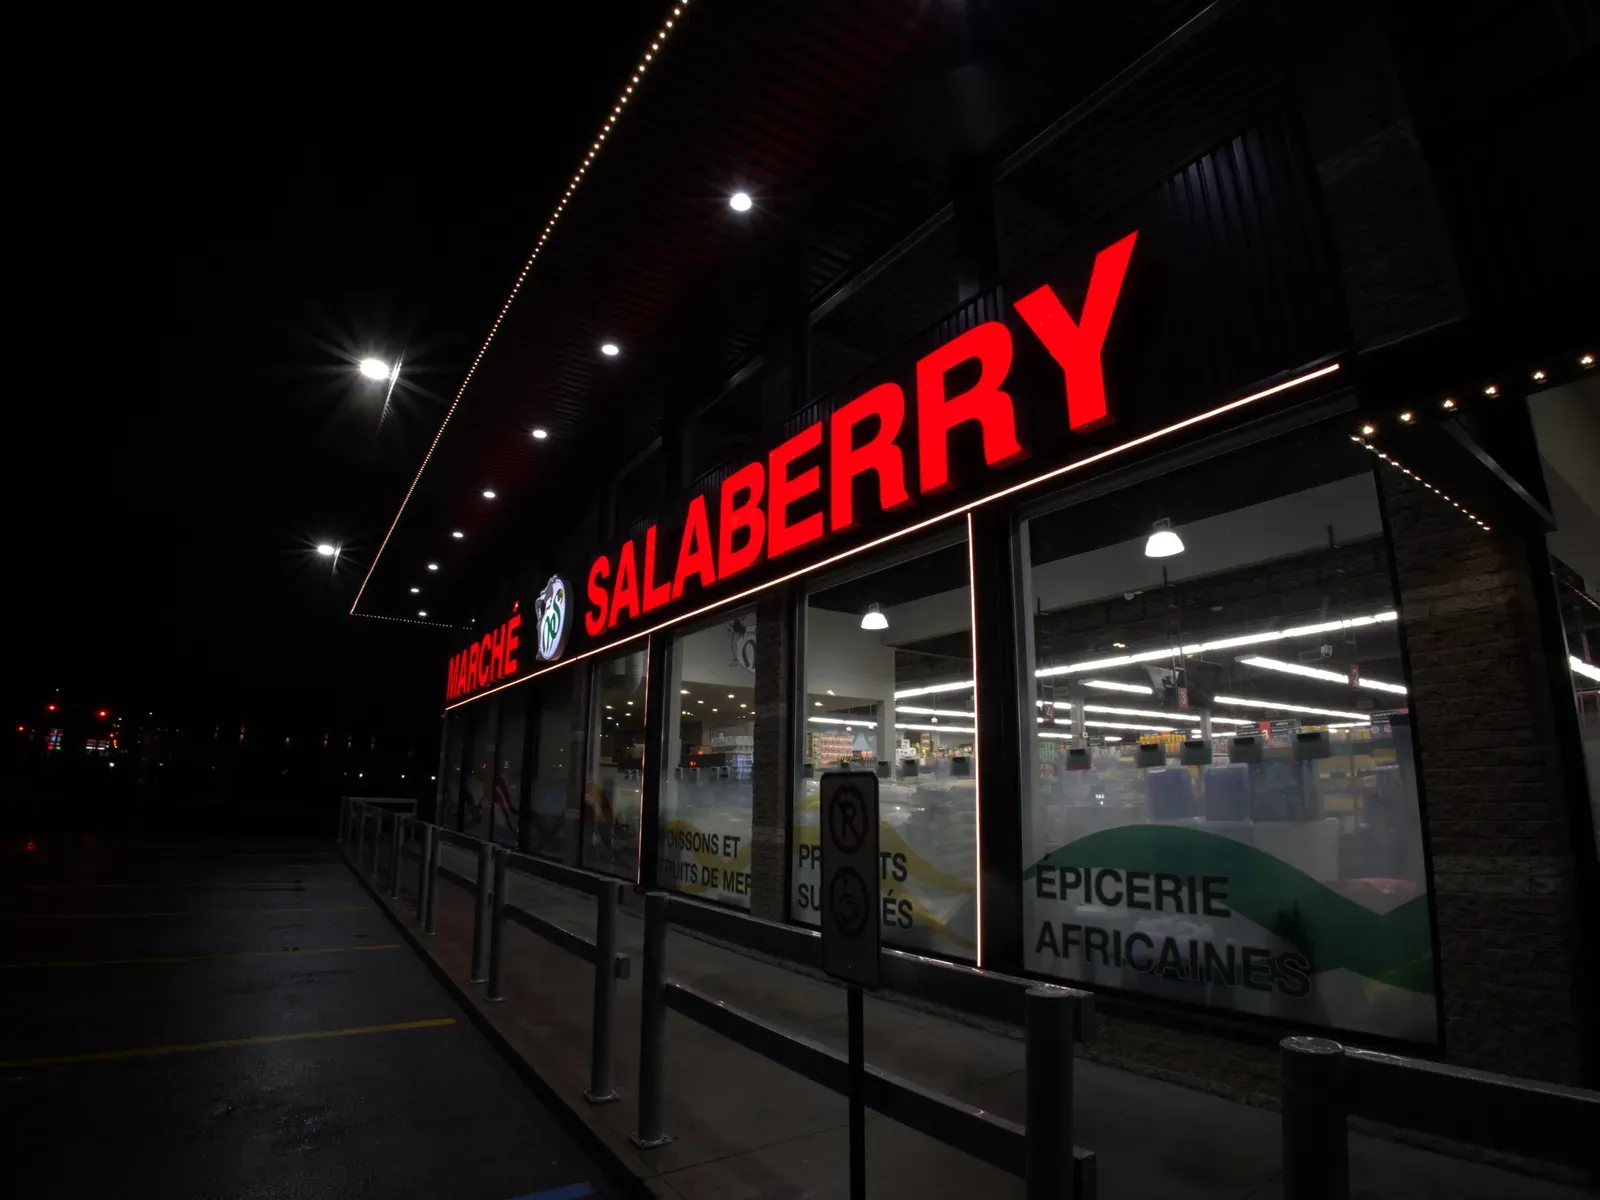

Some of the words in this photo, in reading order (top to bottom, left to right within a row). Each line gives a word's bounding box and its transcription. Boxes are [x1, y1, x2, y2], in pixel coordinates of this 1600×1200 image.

[446, 600, 523, 700] MARCHÉ
[585, 230, 1138, 637] SALABERRY
[665, 831, 719, 855] OISSONS
[723, 835, 740, 858] ET
[702, 865, 719, 888] DE
[1035, 853, 1231, 918] ÉPICERIE
[1035, 920, 1312, 998] AFRICAINES
